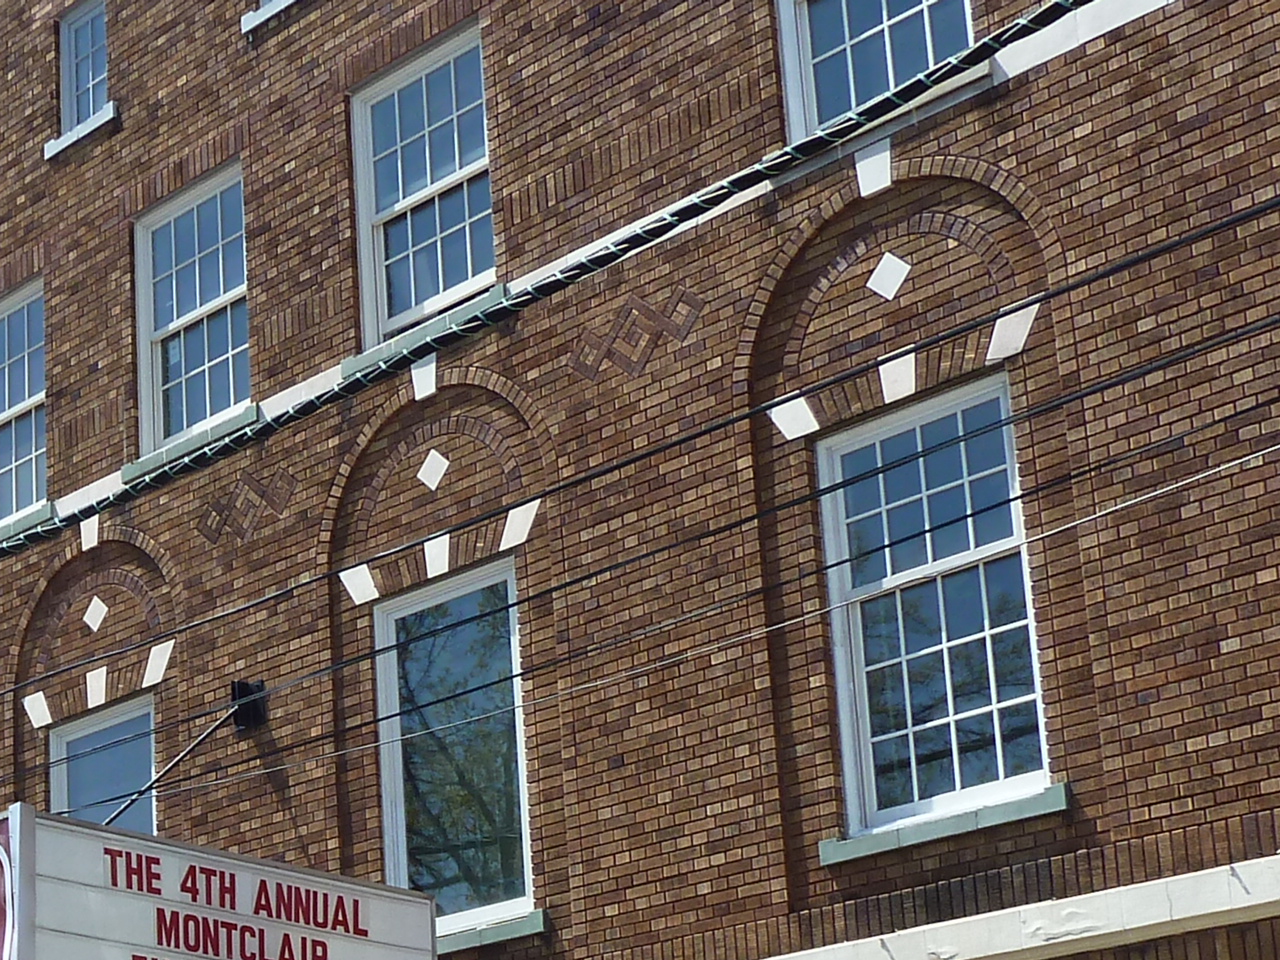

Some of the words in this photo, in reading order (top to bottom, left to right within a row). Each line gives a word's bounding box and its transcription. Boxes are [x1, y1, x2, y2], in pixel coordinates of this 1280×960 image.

[103, 847, 162, 896] THE
[179, 864, 237, 912] 4TH
[253, 879, 369, 938] ANNUAL
